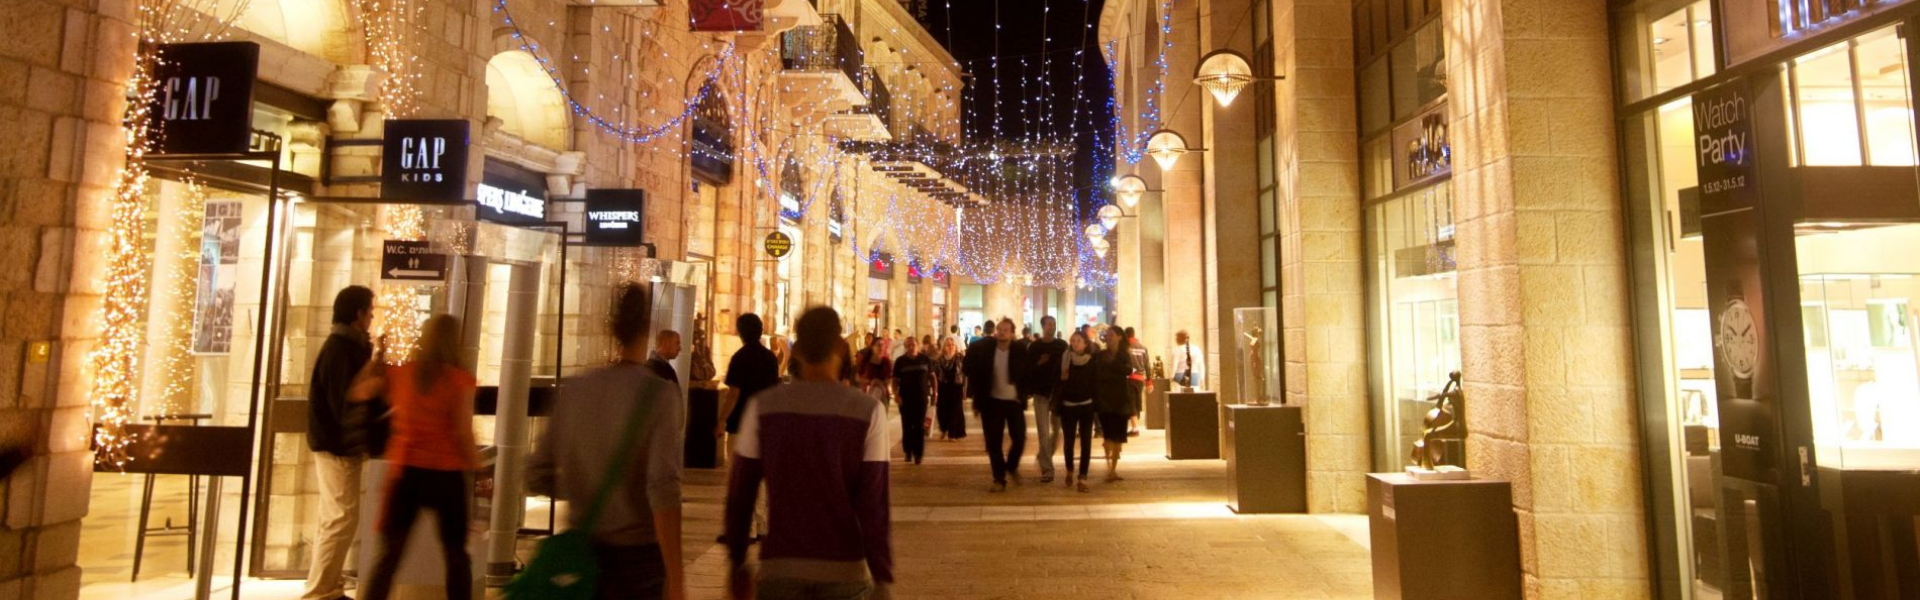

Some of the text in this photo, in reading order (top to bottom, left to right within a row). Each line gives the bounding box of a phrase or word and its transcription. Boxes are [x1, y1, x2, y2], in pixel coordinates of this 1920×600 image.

[164, 76, 220, 121] GAP
[1694, 91, 1746, 132] Watch
[401, 136, 446, 170] GAP
[1700, 128, 1746, 167] Party
[401, 173, 443, 182] KIDS
[588, 210, 640, 222] WHISPERS
[386, 245, 407, 254] W.C.
[1734, 433, 1760, 446] U-BOAT
